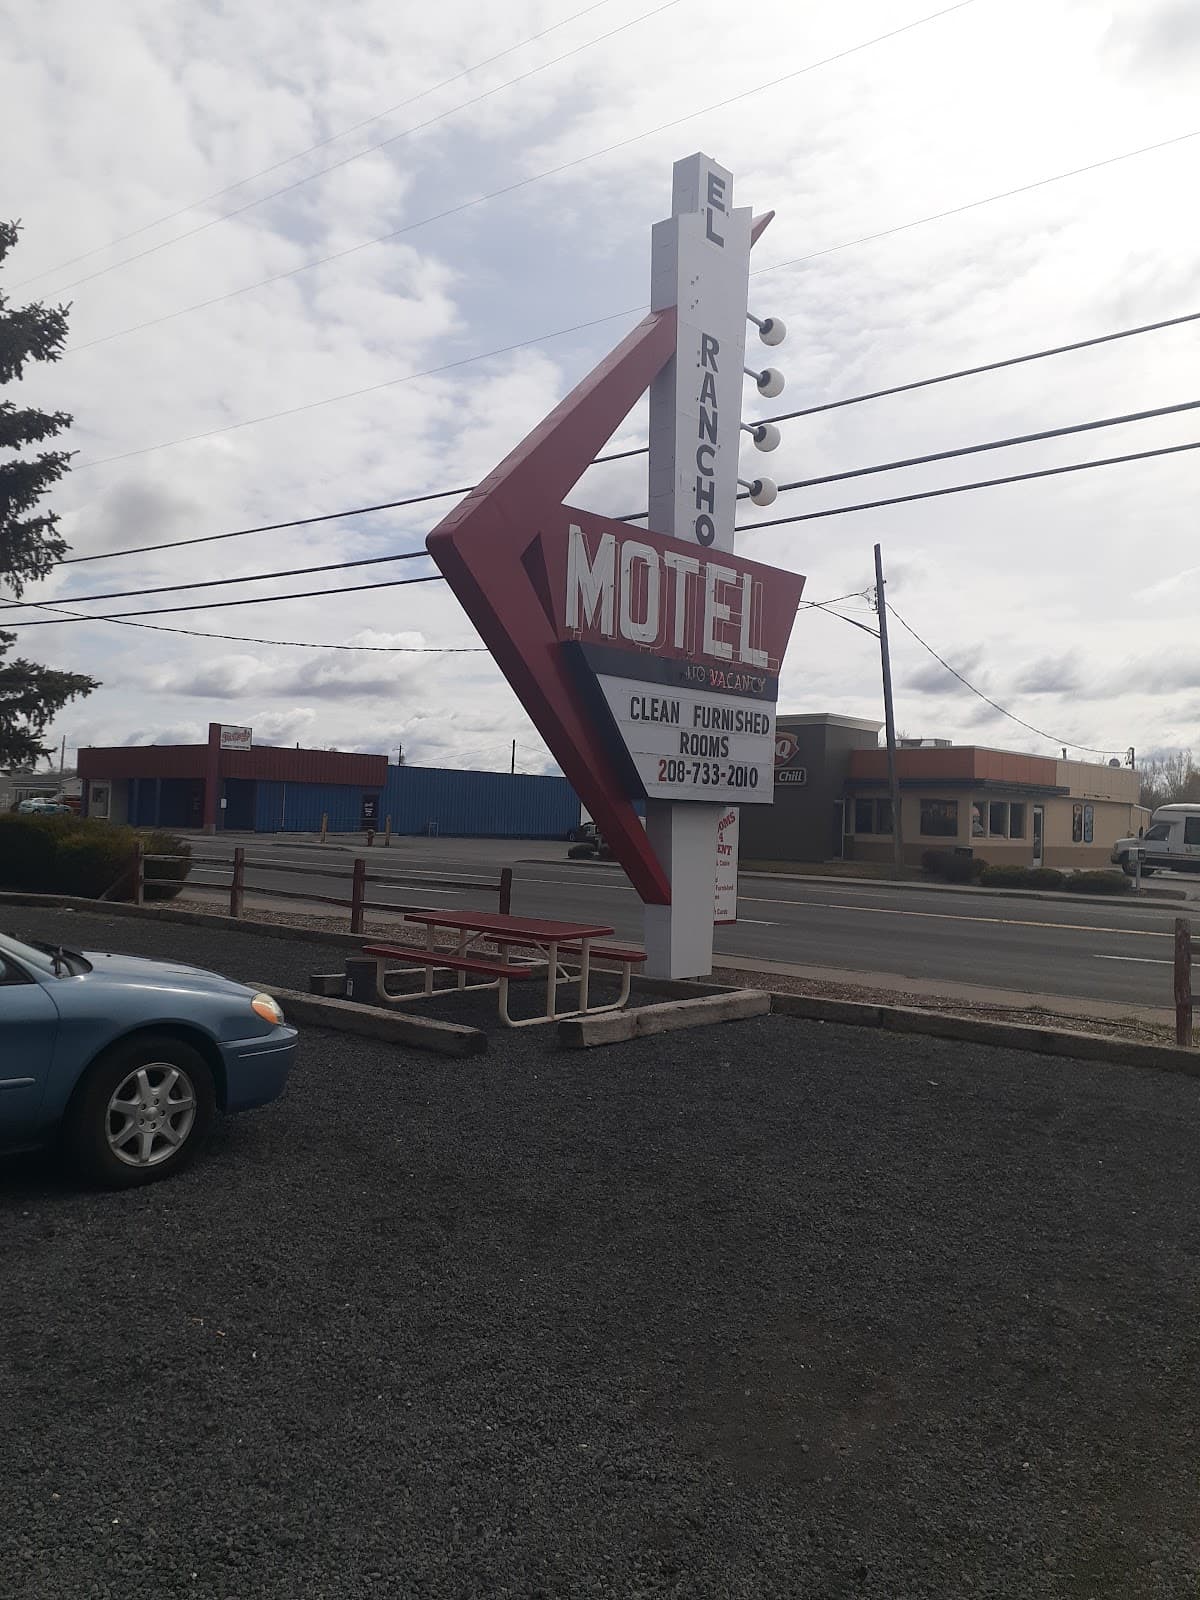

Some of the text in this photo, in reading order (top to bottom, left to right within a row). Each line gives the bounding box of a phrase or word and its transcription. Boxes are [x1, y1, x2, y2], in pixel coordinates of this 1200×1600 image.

[695, 170, 726, 547] EL RANCHO
[565, 523, 770, 669] MOTEL
[709, 668, 767, 694] VACANCY
[630, 696, 770, 736] CLEAN FURNISHED
[680, 731, 729, 758] ROOMS
[775, 739, 792, 759] Q
[658, 759, 759, 789] 208-733-2010
[717, 843, 733, 856] ENT
